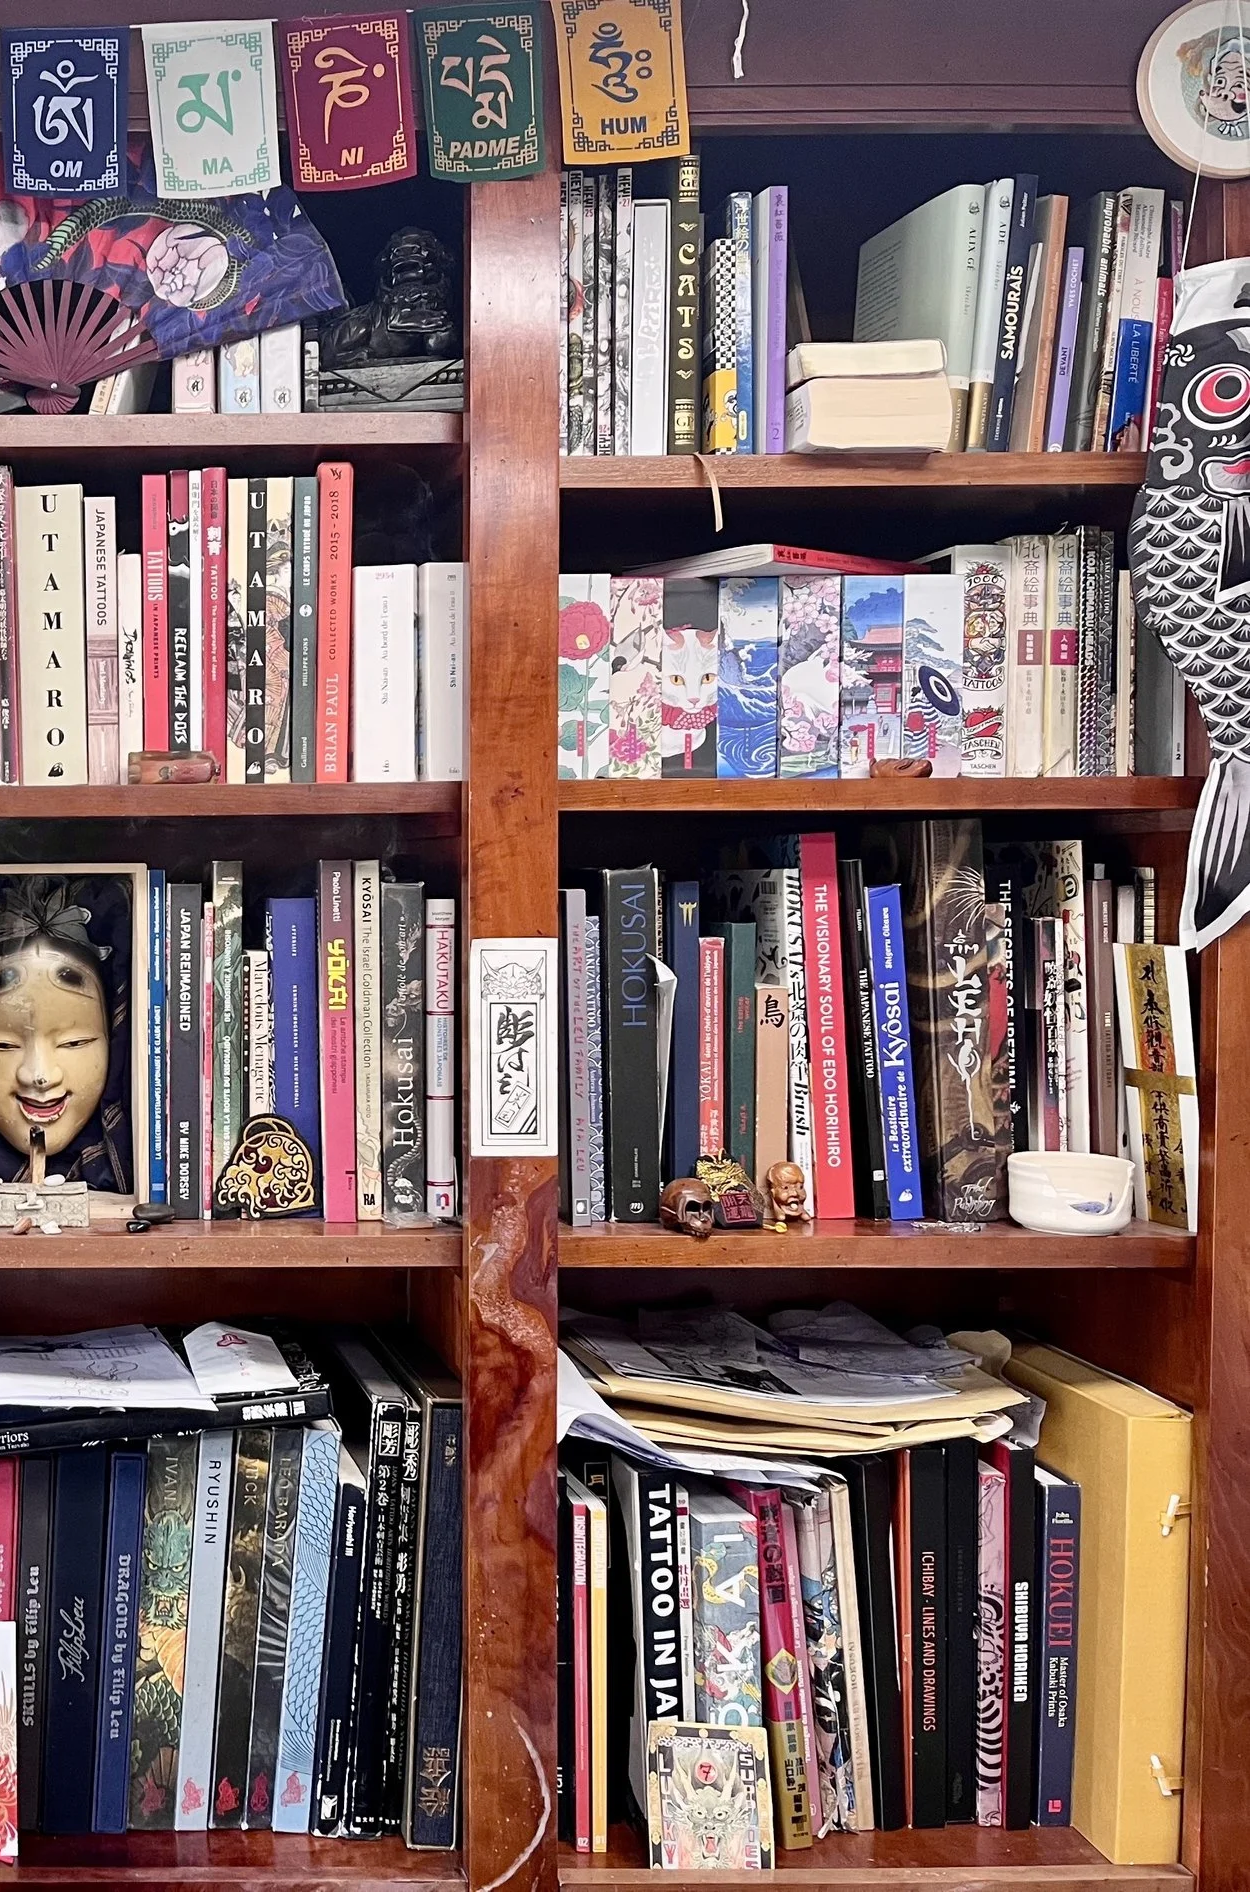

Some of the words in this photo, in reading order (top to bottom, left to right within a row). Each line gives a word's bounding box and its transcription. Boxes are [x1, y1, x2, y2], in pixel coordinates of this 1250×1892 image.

[600, 117, 648, 135] HUM
[50, 161, 82, 178] OM
[203, 156, 234, 175] MA
[571, 173, 581, 197] HEY!
[1100, 198, 1115, 254] Improbable
[1069, 258, 1079, 288] COCHET
[1096, 258, 1108, 296] animals
[1133, 278, 1144, 286] À
[677, 243, 697, 359] CATS
[1000, 265, 1024, 360] SAMOURAÏS
[1069, 290, 1078, 307] YVES
[1131, 292, 1142, 319] NOUS
[1132, 324, 1142, 338] LA
[1058, 346, 1068, 376] DEVANT
[1127, 341, 1141, 384] LIBERTÉ
[95, 508, 107, 574] JAPANESE
[95, 576, 107, 626] TATTOOS
[1022, 541, 1040, 627] 北斎絵事典
[1058, 541, 1075, 627] 北斎絵事典
[41, 494, 65, 748] UTAMARO
[247, 492, 266, 745] UTAMARO
[329, 609, 337, 661] COLLECTED
[174, 627, 188, 682] RECLAIM
[174, 683, 188, 709] THE
[326, 673, 339, 716] PAUL
[963, 669, 1004, 690] TATTOOS
[175, 712, 188, 745] DOTS
[325, 721, 337, 773] BRIAN
[963, 739, 1001, 751] TASCHEN
[814, 884, 828, 913] THE
[179, 908, 190, 949] JAPAN
[881, 907, 891, 937] Oikawa
[436, 930, 449, 1010] HAKUTAKU
[621, 884, 647, 1027] HOKUSAI
[816, 914, 831, 993] VISIONARY
[883, 939, 893, 969] Shigeru
[179, 953, 191, 1032] REIMAGINED
[253, 959, 267, 1031] Marvelous
[858, 968, 869, 989] THE
[759, 995, 785, 1029] 鳥
[819, 995, 833, 1033] SOUL
[859, 990, 872, 1038] JAPANESE
[879, 981, 908, 1068] Kyôsai
[821, 1035, 835, 1056] OF
[862, 1039, 875, 1078] TATTOO
[251, 1033, 267, 1104] Menagerie
[822, 1059, 837, 1090] EDO
[897, 1070, 905, 1082] de
[392, 1038, 415, 1146] Hokusai
[179, 1121, 189, 1134] BY
[825, 1093, 841, 1167] HORIHIRO
[887, 1095, 899, 1142] Bestiaire
[897, 1084, 912, 1173] extraordinaire
[179, 1137, 189, 1160] MIKE
[892, 1143, 899, 1152] Le
[179, 1162, 189, 1200] DORSEY
[164, 1456, 179, 1502] IVAN
[204, 1459, 221, 1545] RYUSHIN
[573, 1515, 586, 1586] DISINTEGRATION
[27, 1566, 39, 1594] Leu
[922, 1551, 935, 1597] ICHIBAY
[1048, 1537, 1074, 1648] HOKUEI
[25, 1598, 40, 1635] Filip
[922, 1606, 935, 1638] LINES
[25, 1639, 39, 1659] by
[111, 1644, 126, 1664] by
[922, 1641, 935, 1666] AND
[109, 1667, 125, 1705] Filip
[1049, 1657, 1058, 1688] Kabuki
[1059, 1657, 1069, 1688] Master
[22, 1662, 36, 1727] SKULLS
[923, 1669, 936, 1731] DRAWINGS
[1048, 1691, 1058, 1717] Prints
[1059, 1689, 1069, 1699] of
[109, 1710, 123, 1739] Leu
[1058, 1700, 1068, 1728] Osaka
[659, 1753, 676, 1865] LUCKY
